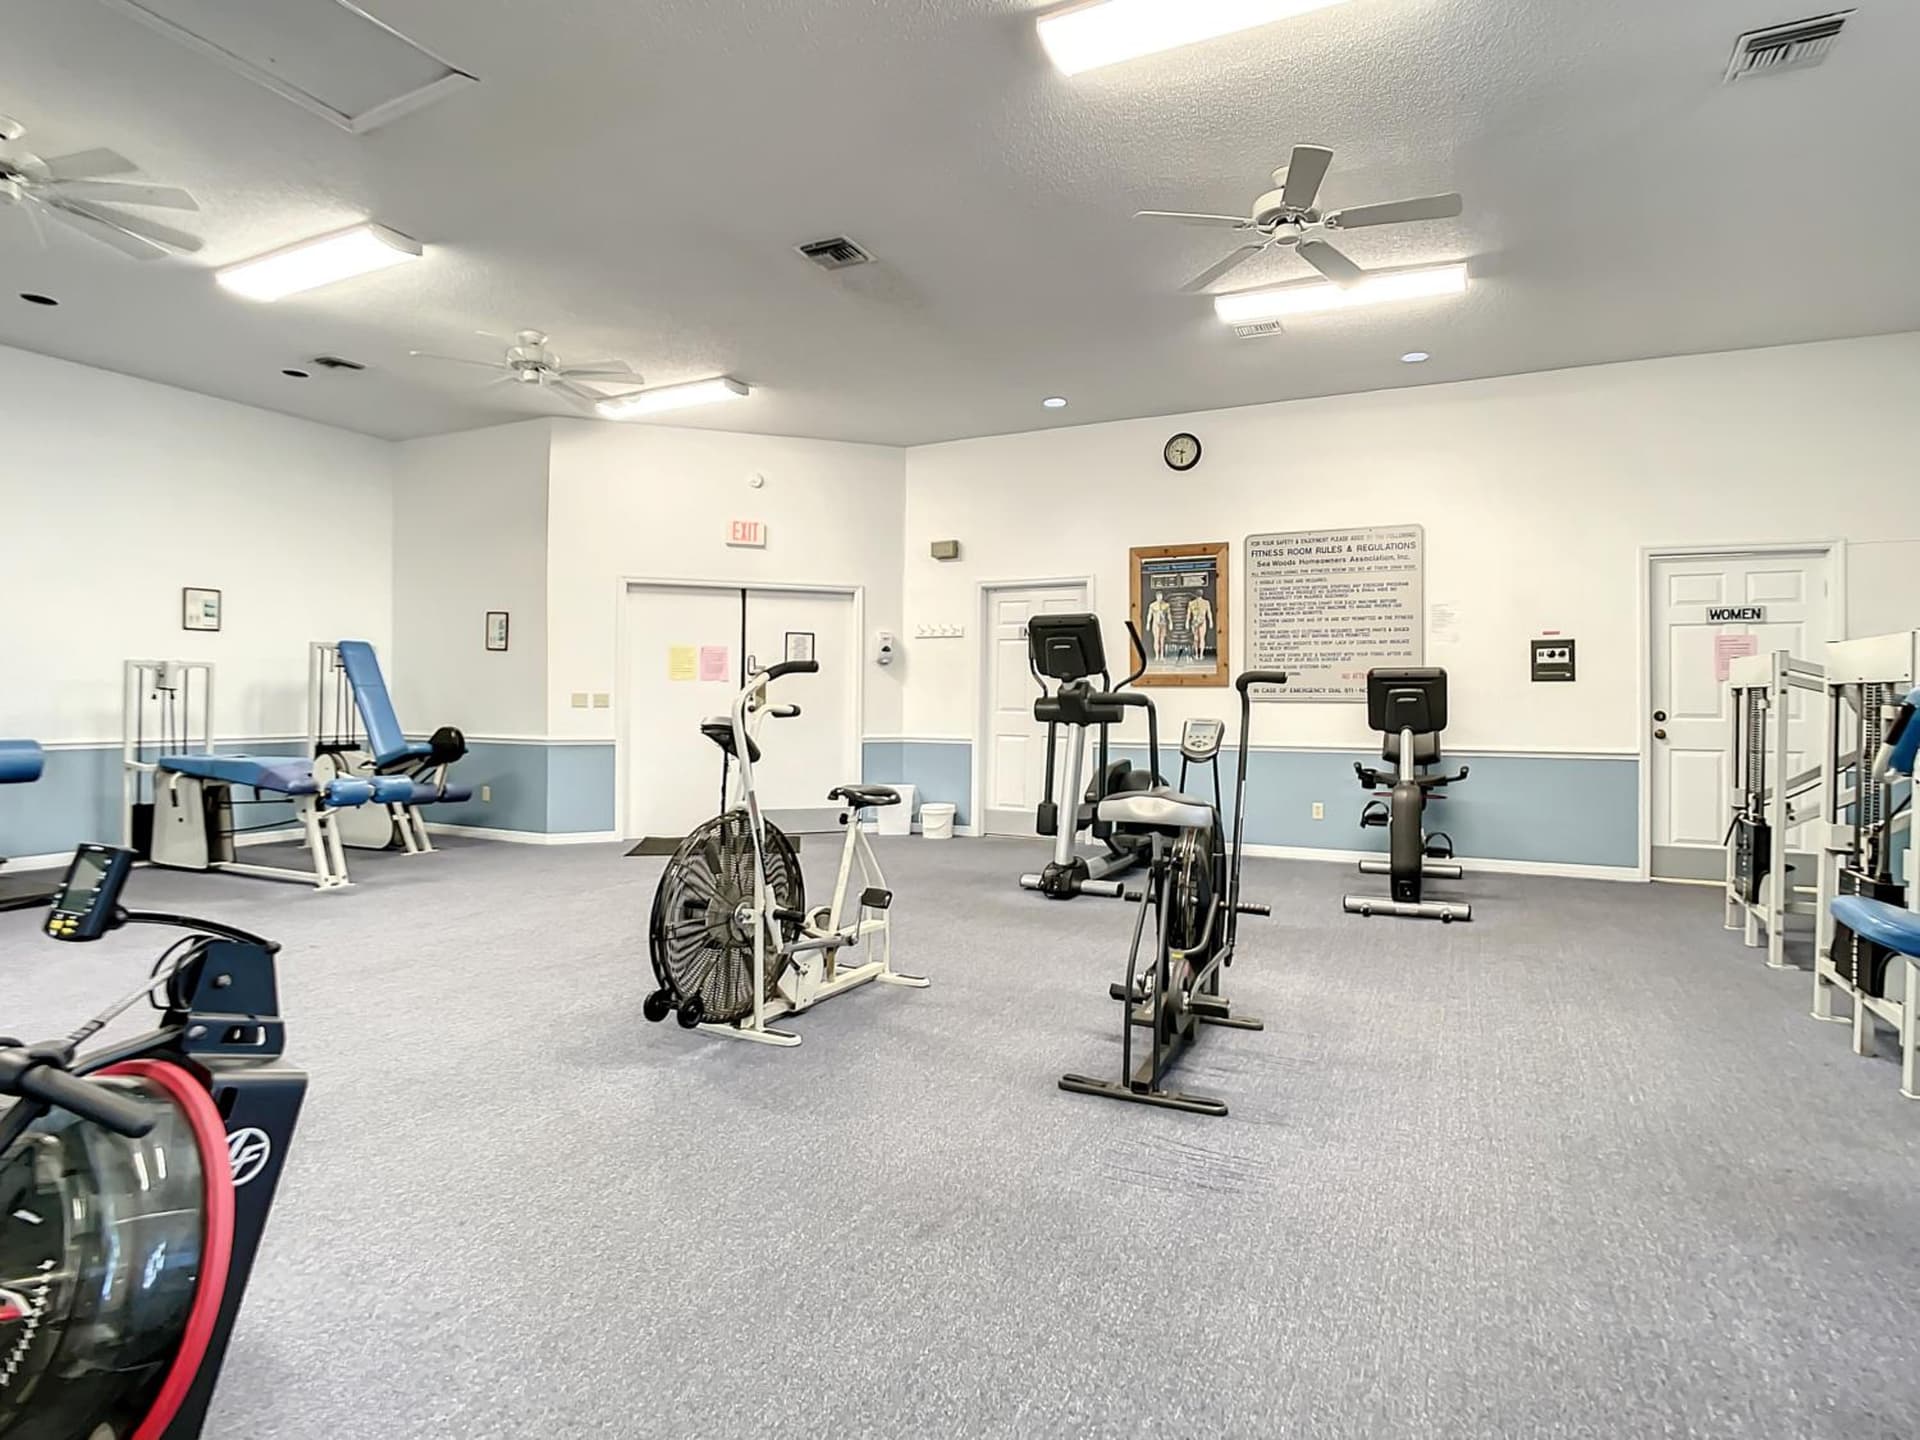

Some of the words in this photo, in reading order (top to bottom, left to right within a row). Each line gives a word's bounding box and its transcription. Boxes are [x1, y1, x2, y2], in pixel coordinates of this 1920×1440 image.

[732, 520, 760, 542] EXIT
[1251, 548, 1284, 558] FITNESS
[1287, 547, 1312, 556] ROOM
[1315, 545, 1343, 554] RULES
[1346, 544, 1352, 552] &
[1356, 541, 1417, 552] REGULATIONS
[1298, 557, 1346, 565] Homeowners
[1710, 608, 1761, 620] WOMEN
